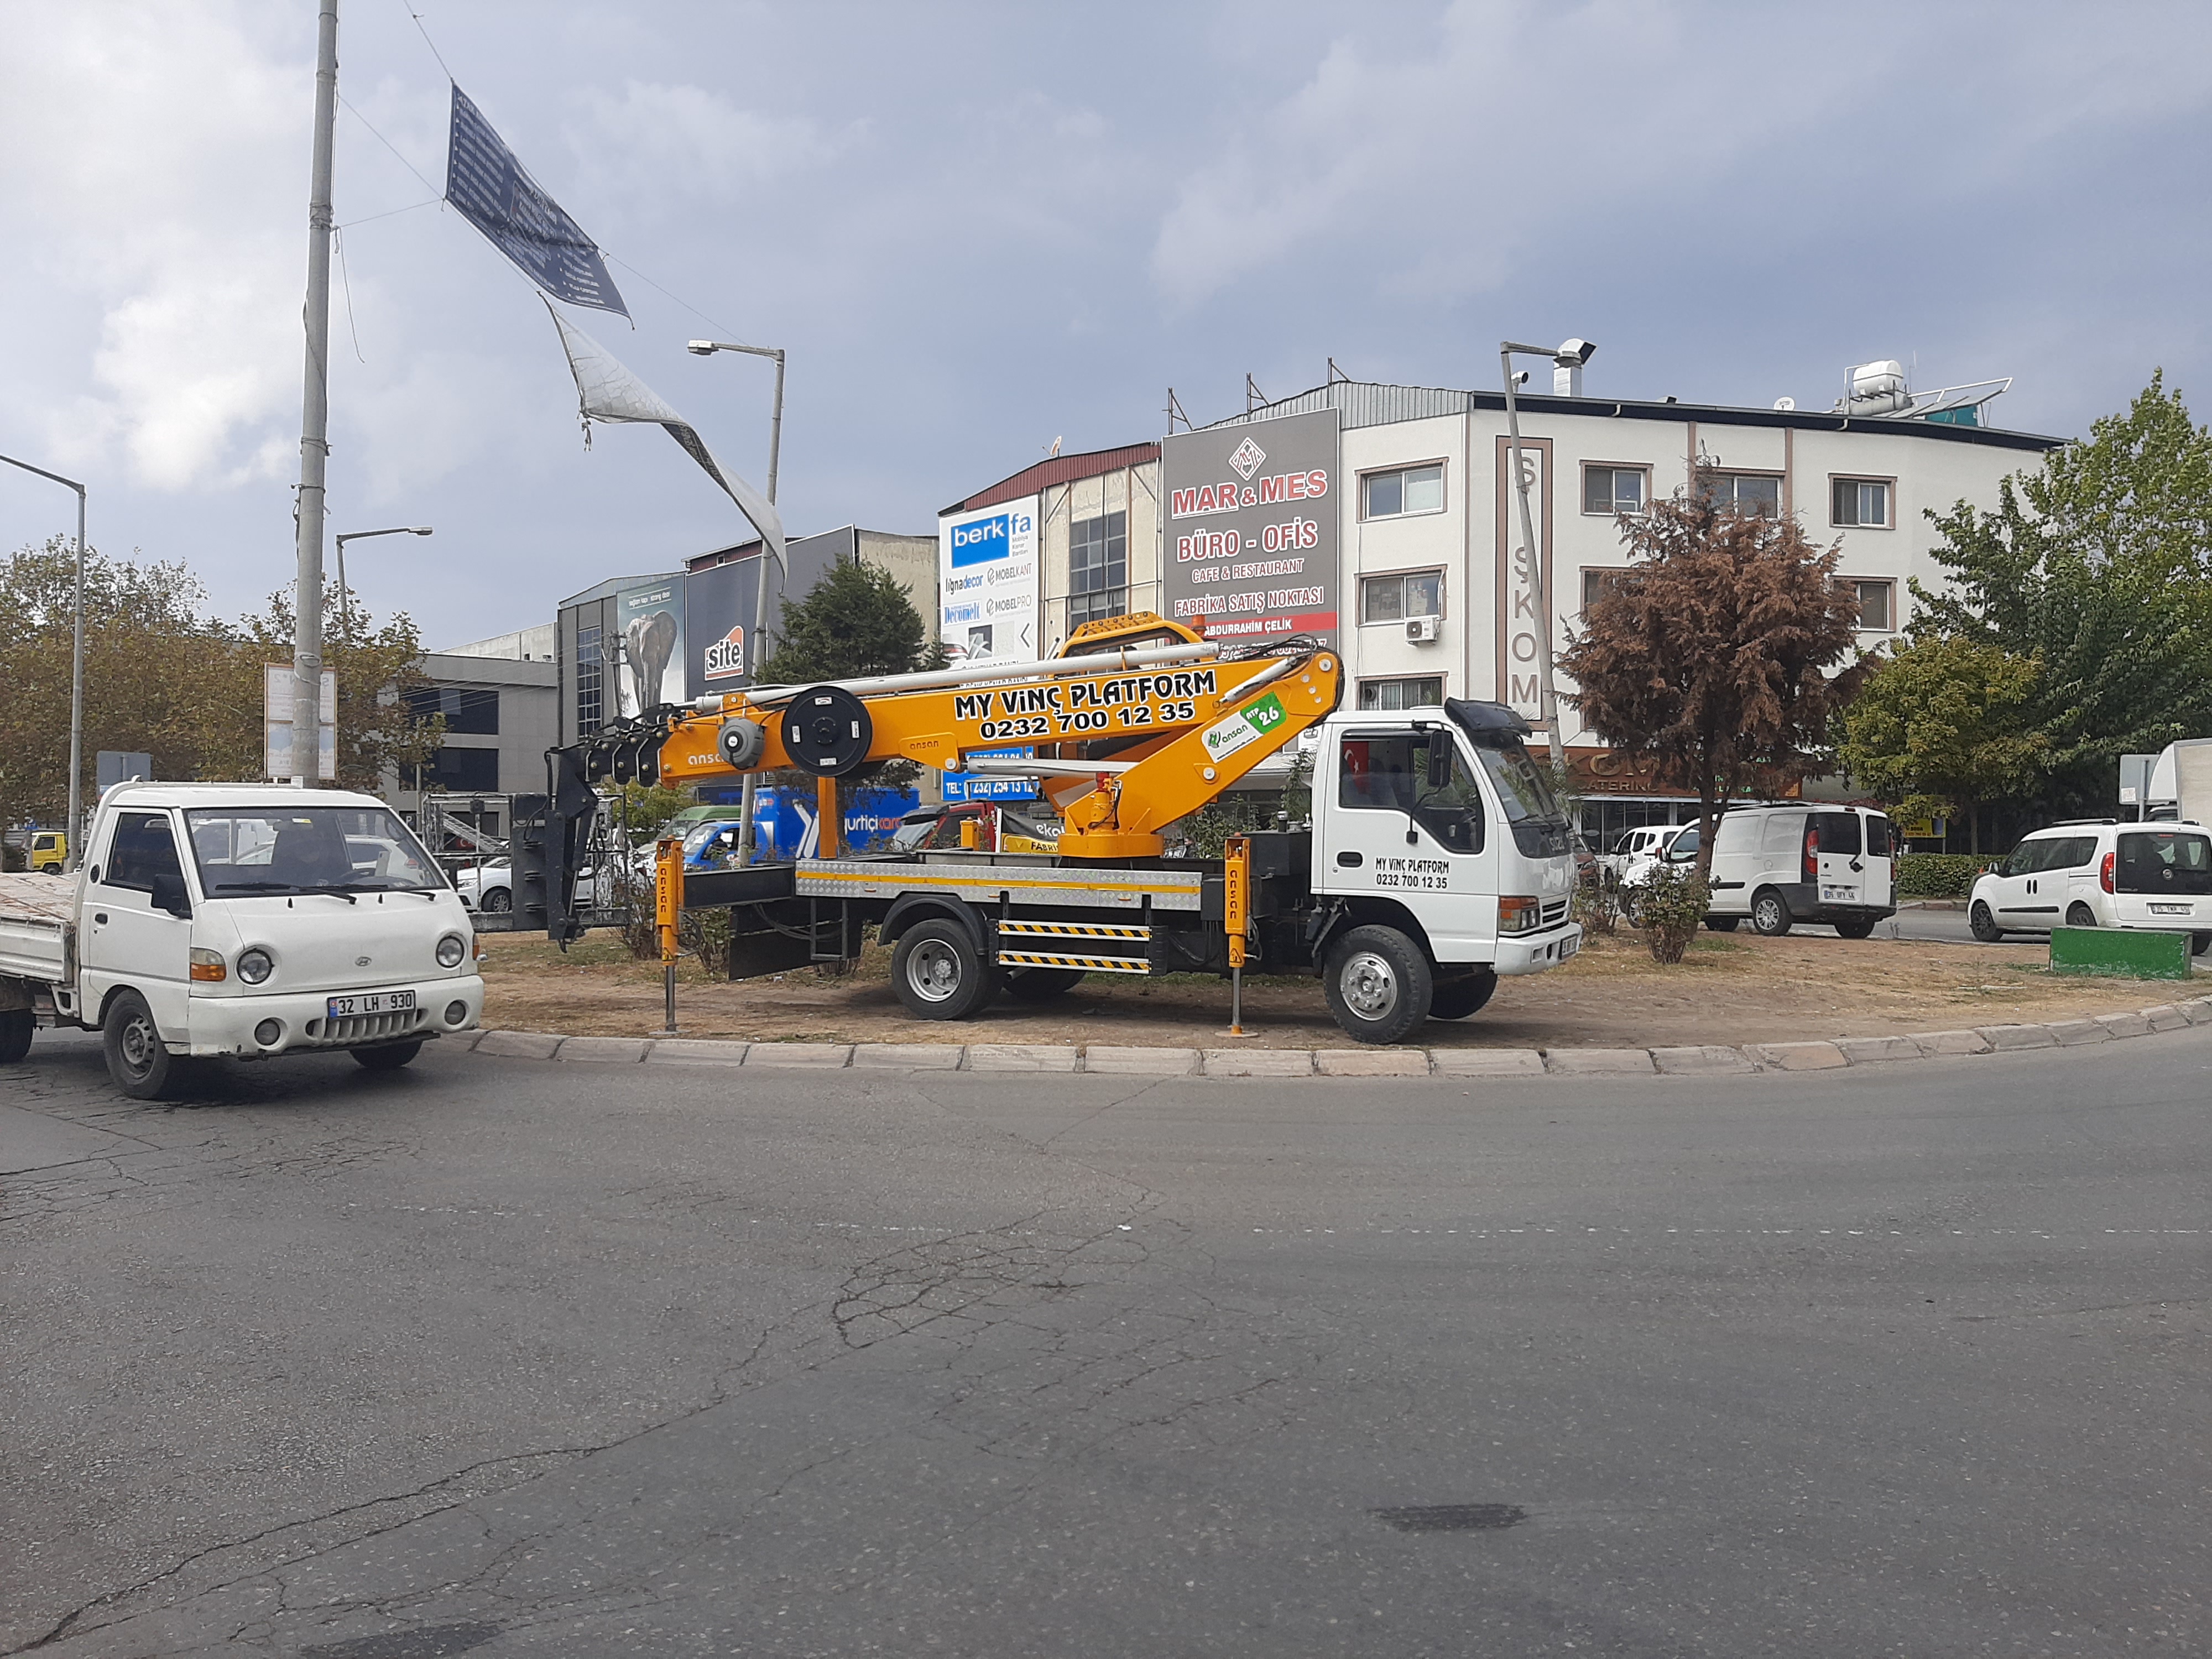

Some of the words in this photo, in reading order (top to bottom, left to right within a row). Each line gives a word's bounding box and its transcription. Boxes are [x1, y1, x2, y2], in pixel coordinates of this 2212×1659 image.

[1172, 482, 1238, 517] MAR
[1240, 487, 1257, 507] &
[1259, 469, 1328, 504] MES
[1177, 529, 1240, 562] BÜRO
[1262, 517, 1318, 552] OFİS
[1192, 568, 1219, 583] CAFE
[1222, 567, 1230, 580] &
[1233, 559, 1305, 579] RESTAURANT
[1175, 593, 1227, 617] FABRİKA
[1228, 592, 1264, 614] SATIŞ
[1267, 586, 1324, 608] NOKTASI
[1204, 620, 1262, 636] ABDURRAHİM
[1265, 617, 1292, 634] ÇELİK
[708, 641, 740, 669] site
[954, 693, 994, 720] MY
[1070, 670, 1216, 707] PLATFORM
[980, 717, 1049, 739] 0232
[1057, 711, 1109, 732] 700
[1118, 706, 1151, 726] 12
[1160, 702, 1194, 722] 35
[1246, 707, 1259, 720] ATP
[1259, 706, 1279, 726] 26
[910, 740, 939, 749] ansan
[1222, 724, 1248, 743] ansan
[1376, 858, 1386, 871] MY
[1408, 859, 1449, 874] PLATFORM
[1376, 874, 1399, 886] 0232
[1402, 875, 1418, 886] 700
[1422, 876, 1433, 888] 12
[1436, 877, 1447, 889] 35
[338, 999, 354, 1014] 32
[364, 997, 379, 1011] LH
[390, 993, 413, 1008] 930
